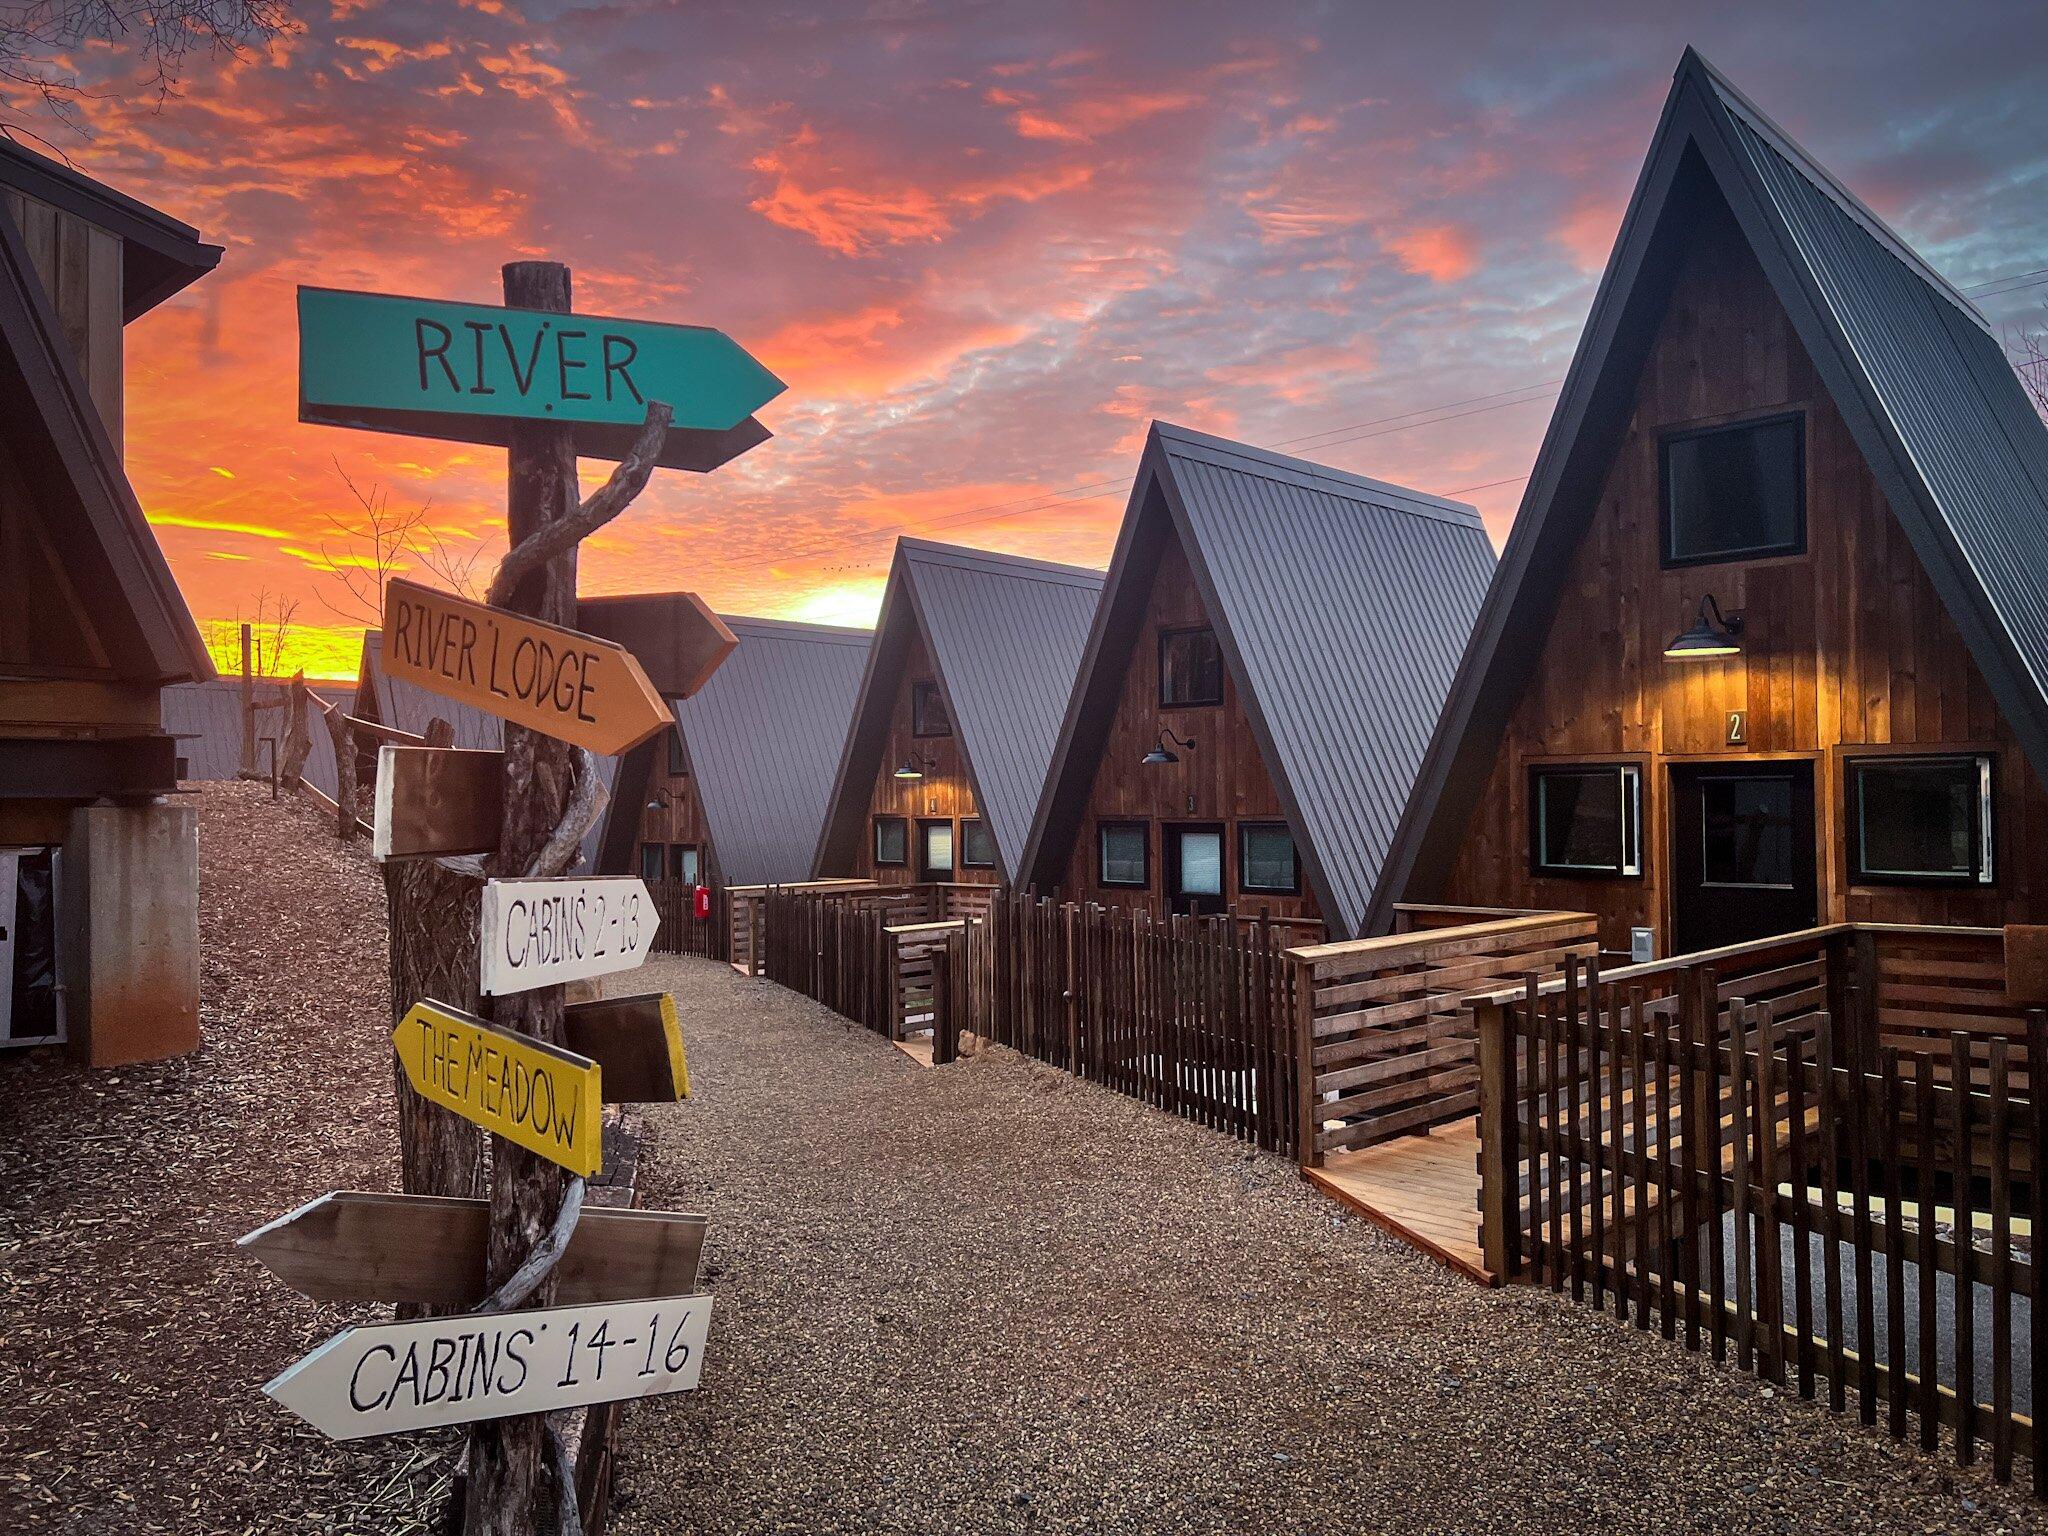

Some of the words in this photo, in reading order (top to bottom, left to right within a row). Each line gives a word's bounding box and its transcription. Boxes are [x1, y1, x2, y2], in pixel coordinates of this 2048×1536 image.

[415, 318, 644, 405] RIVER
[394, 601, 476, 685] RIVER
[490, 626, 600, 724] LODGE
[1730, 714, 1741, 740] 2
[506, 896, 586, 968] CABINS
[593, 893, 640, 958] 2-13
[416, 1018, 459, 1097] THE
[464, 1041, 578, 1150] MEADOW
[349, 1328, 534, 1412] CABINS
[556, 1311, 692, 1388] 14-16
